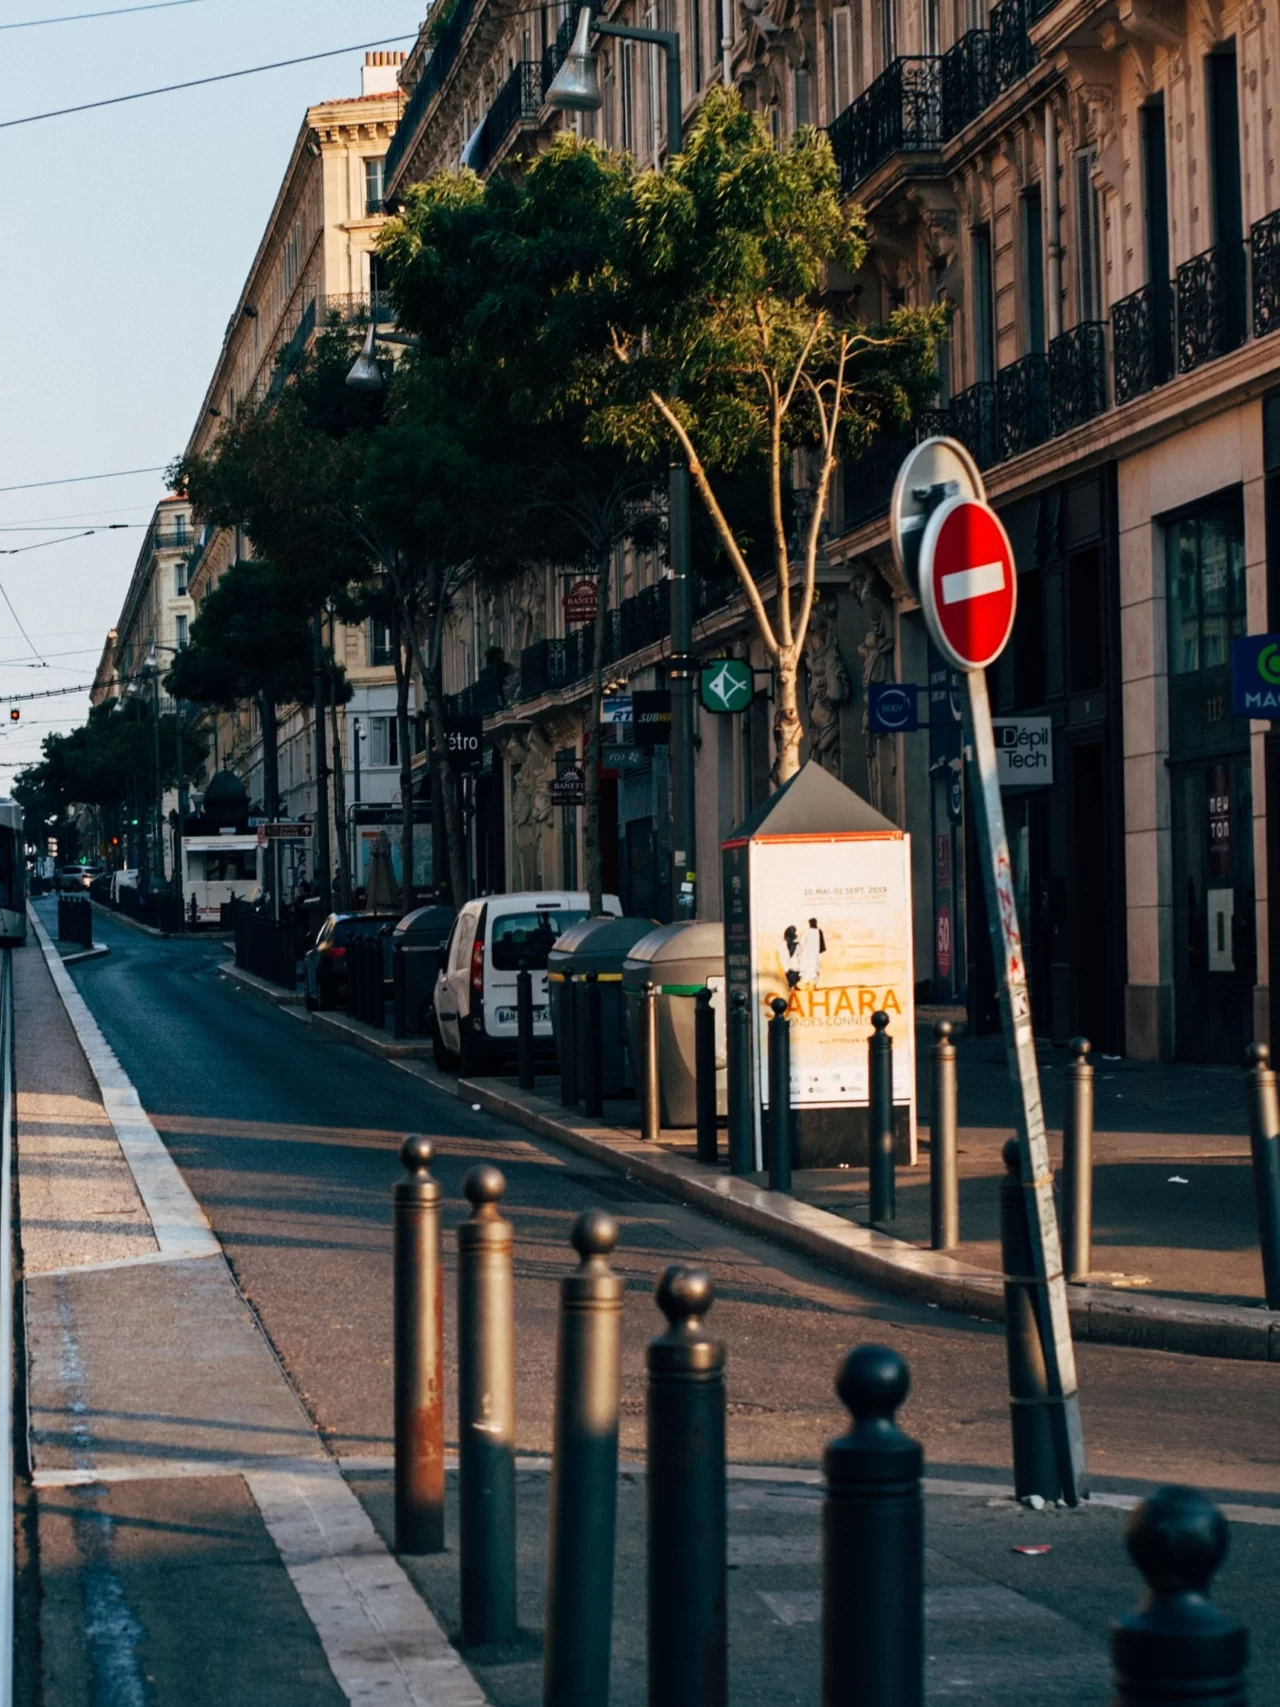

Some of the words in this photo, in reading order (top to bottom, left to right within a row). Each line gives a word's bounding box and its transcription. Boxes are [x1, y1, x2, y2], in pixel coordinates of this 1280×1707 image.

[567, 597, 598, 605] BANETT
[1245, 691, 1280, 708] MA
[612, 711, 632, 721] RT
[638, 712, 672, 723] SUBWA
[444, 732, 479, 750] étro
[1003, 727, 1048, 751] Dépil
[1004, 750, 1047, 768] Tech
[553, 782, 585, 790] BANETT
[764, 989, 902, 1018] SAHARA
[789, 1018, 823, 1028] ONDES
[829, 1015, 872, 1026] CONNEC
